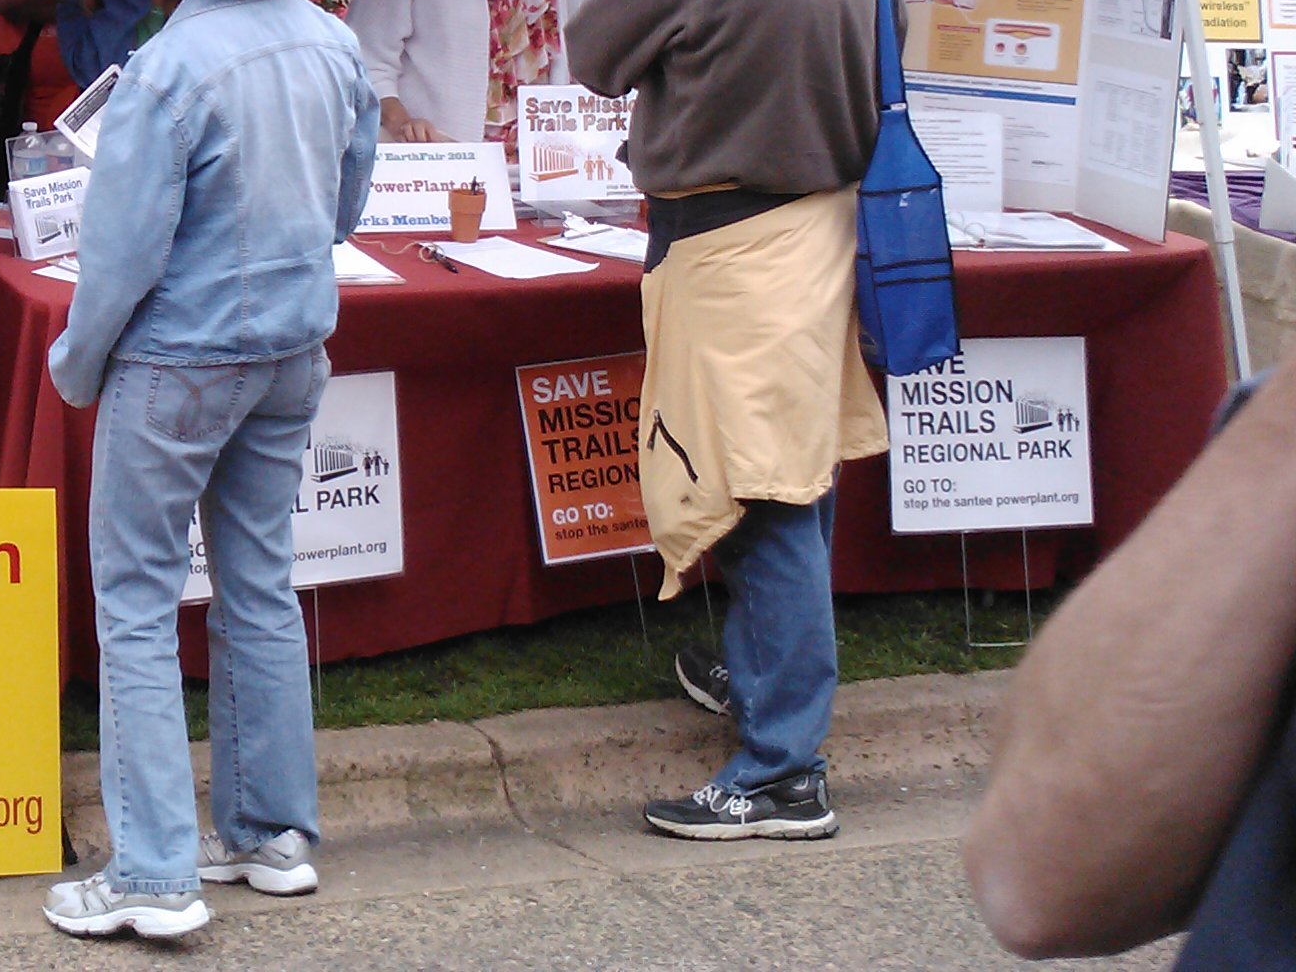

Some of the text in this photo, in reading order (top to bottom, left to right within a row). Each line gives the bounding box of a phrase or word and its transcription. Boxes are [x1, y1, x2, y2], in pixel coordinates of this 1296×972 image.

[526, 95, 635, 114] Save Missi
[526, 114, 627, 131] Trails Park
[385, 152, 446, 161] EarthFair
[447, 152, 476, 161] 2012
[24, 179, 82, 199] Save Mission
[26, 192, 73, 209] Trails Park
[392, 214, 452, 226] Membe
[532, 370, 612, 403] SAVE
[901, 379, 1014, 406] MISSION
[538, 397, 640, 434] MISSIO
[901, 410, 996, 436] TRAILS
[904, 439, 1072, 464] REGIONAL PARK
[548, 463, 640, 494] REGION
[904, 478, 956, 494] GO TO:
[317, 484, 380, 511] PARK
[904, 492, 1079, 511] stop the santee powerplant.org
[552, 503, 614, 525] GO TO:
[555, 517, 649, 540] stop the sante
[189, 563, 210, 576] top
